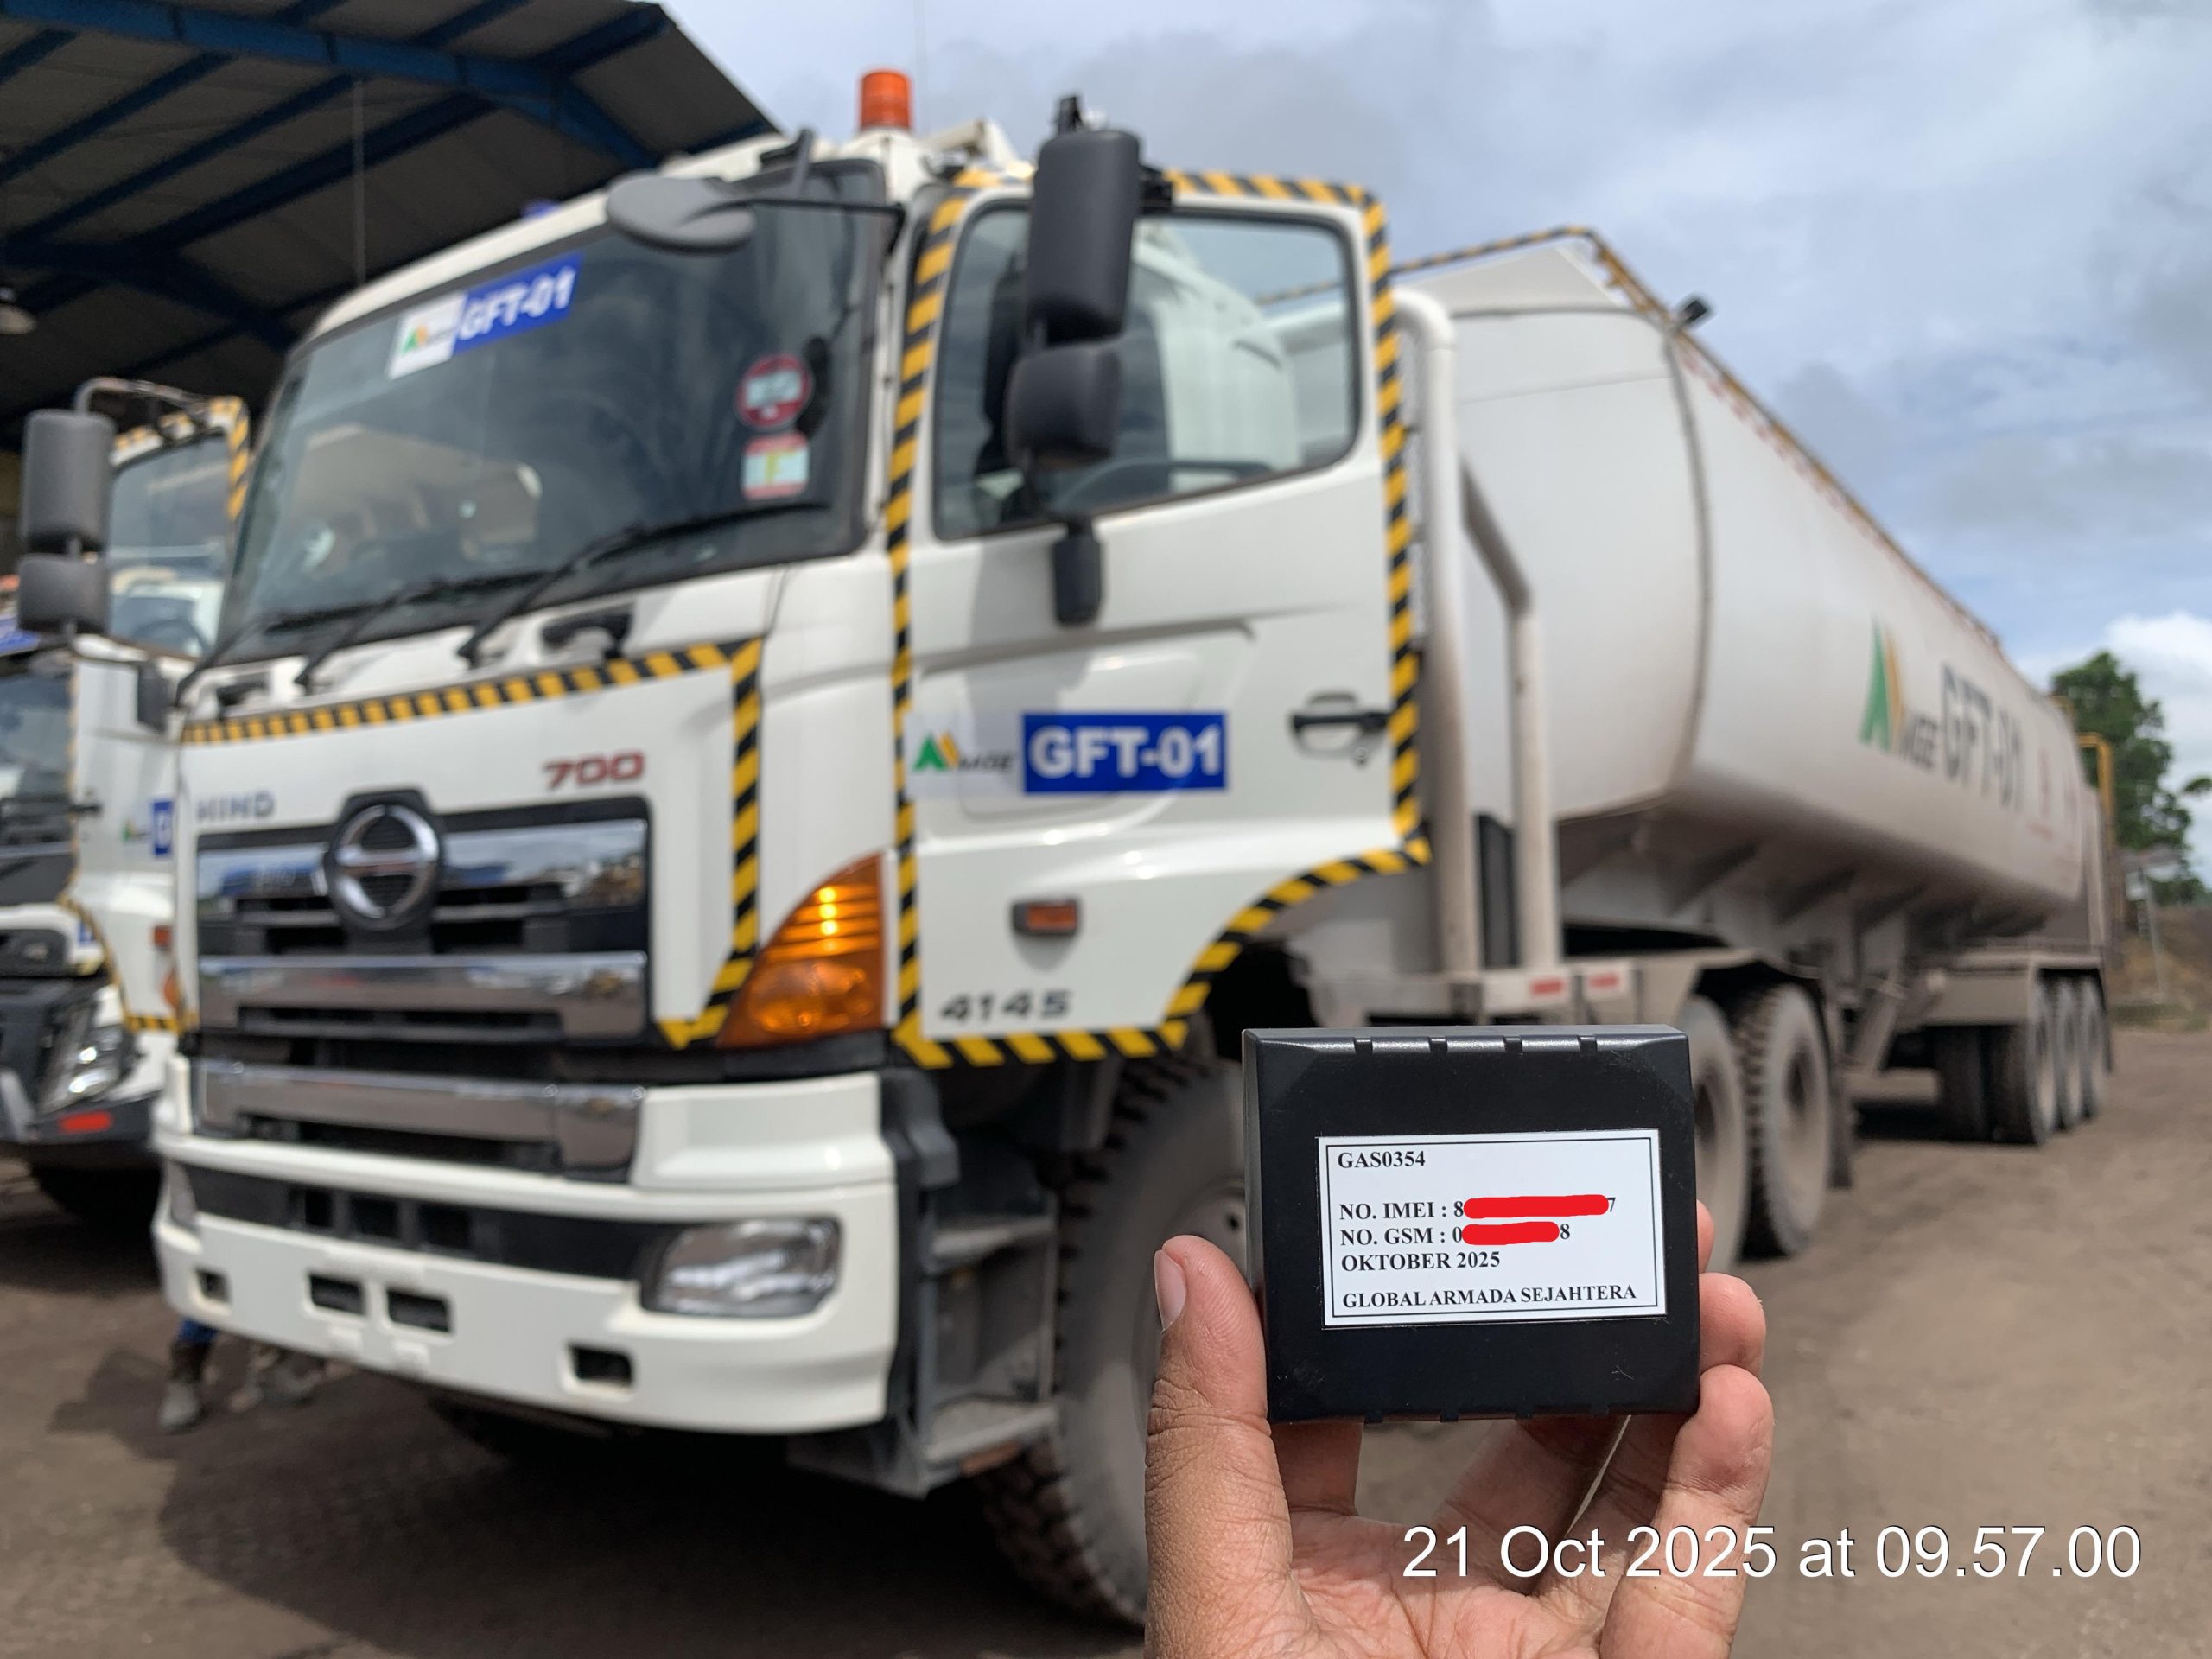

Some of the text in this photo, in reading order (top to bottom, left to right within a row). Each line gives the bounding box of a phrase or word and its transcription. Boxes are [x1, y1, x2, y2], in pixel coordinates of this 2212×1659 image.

[457, 266, 577, 341] GFT-01
[1028, 725, 1221, 778] GFT-01
[542, 750, 646, 791] 700
[938, 988, 1072, 1025] 4145
[1338, 1150, 1426, 1168] GAS0354
[1339, 1203, 1377, 1220] NO.
[1383, 1201, 1434, 1219] IMEI
[1340, 1229, 1377, 1246] NO.
[1384, 1227, 1433, 1245] GSM
[1341, 1251, 1500, 1272] OKTOBER 2025
[1343, 1285, 1637, 1308] GLOBAL ARMADA SEJAHTERA
